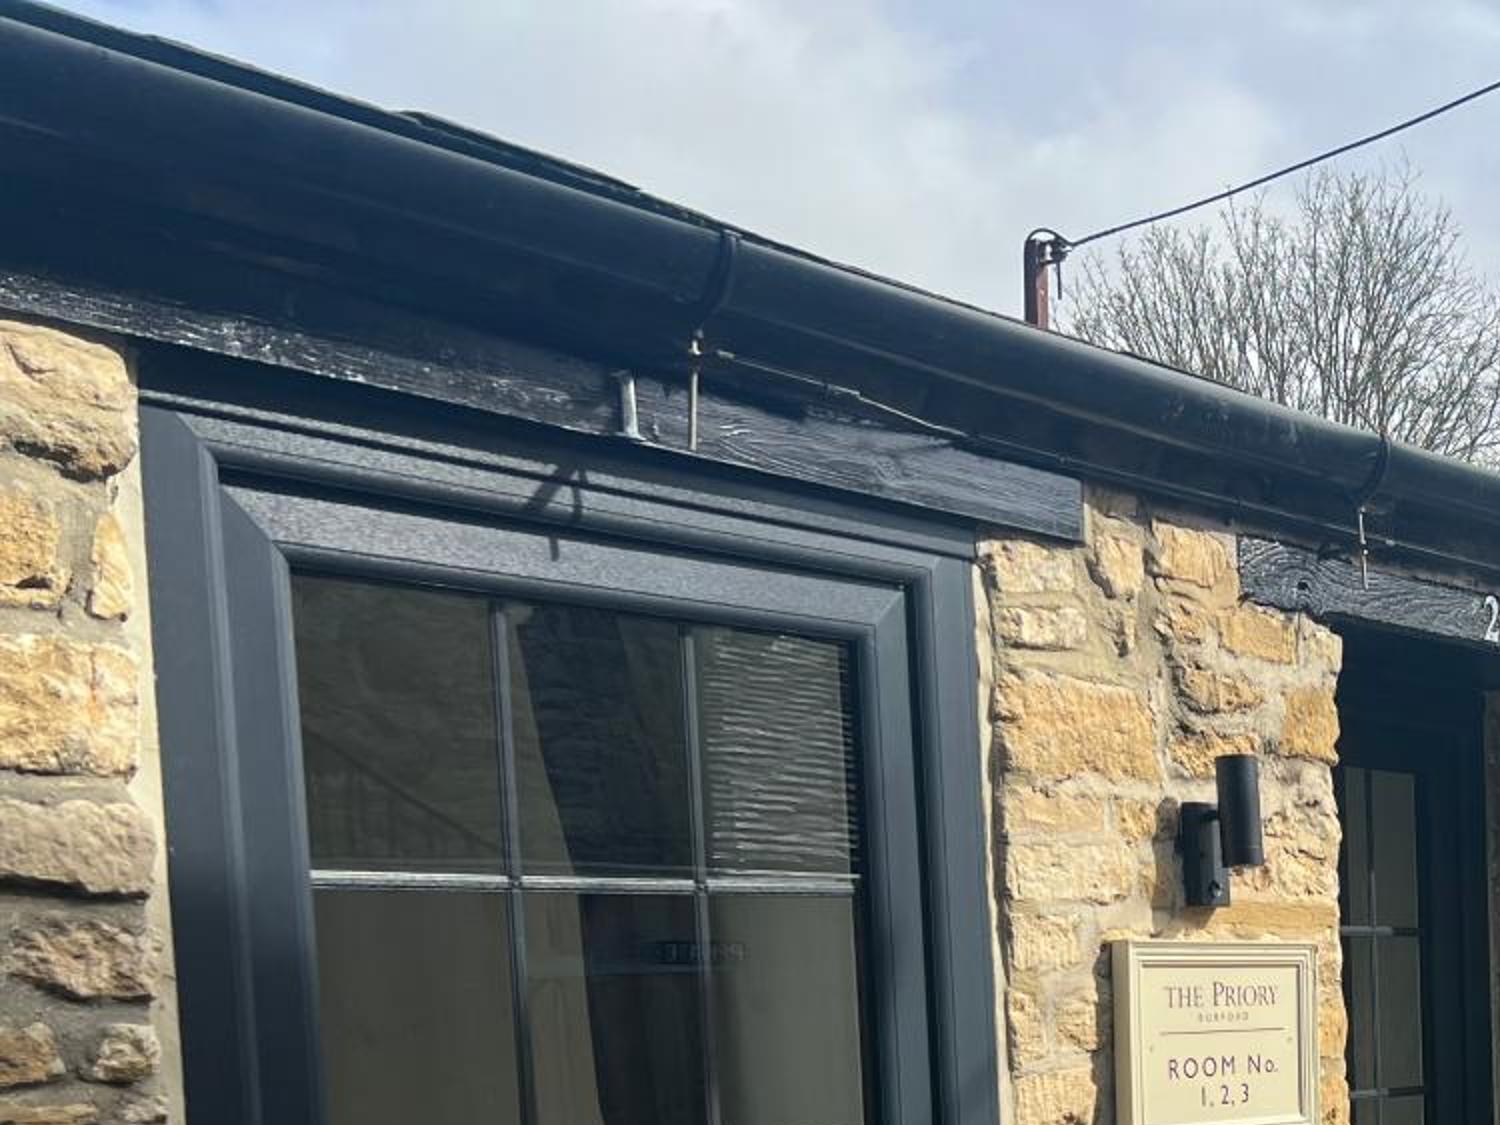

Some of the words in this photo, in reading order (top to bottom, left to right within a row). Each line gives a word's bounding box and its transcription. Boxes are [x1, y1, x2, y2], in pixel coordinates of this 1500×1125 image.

[1483, 594, 1500, 643] 2
[1163, 986, 1204, 1009] THE
[1213, 981, 1278, 1007] PRIORY
[1167, 1055, 1236, 1080] ROOM
[1247, 1053, 1279, 1075] No.
